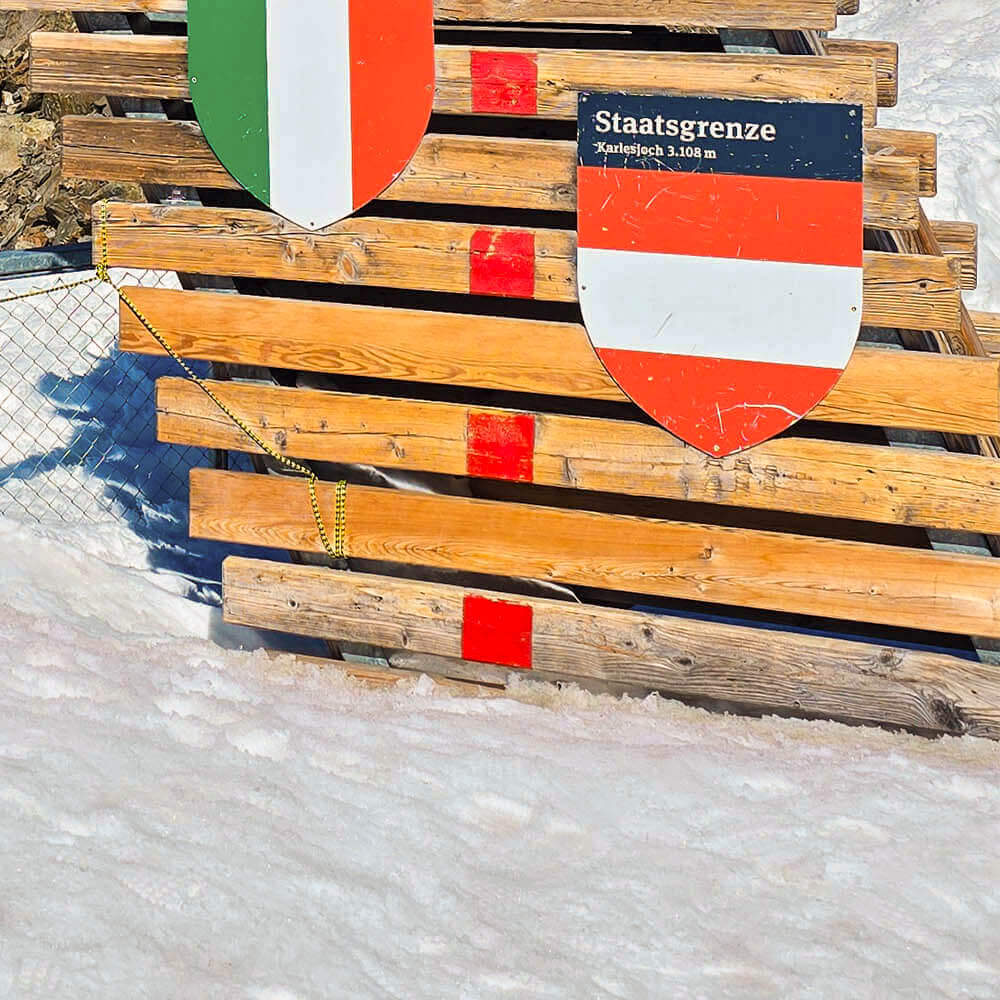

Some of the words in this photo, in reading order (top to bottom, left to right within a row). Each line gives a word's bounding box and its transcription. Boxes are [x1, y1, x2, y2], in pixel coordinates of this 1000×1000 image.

[594, 110, 777, 142] Staatsgrenze
[596, 142, 665, 158] Karlesjoch
[667, 145, 701, 158] 3.108
[703, 149, 717, 159] m
